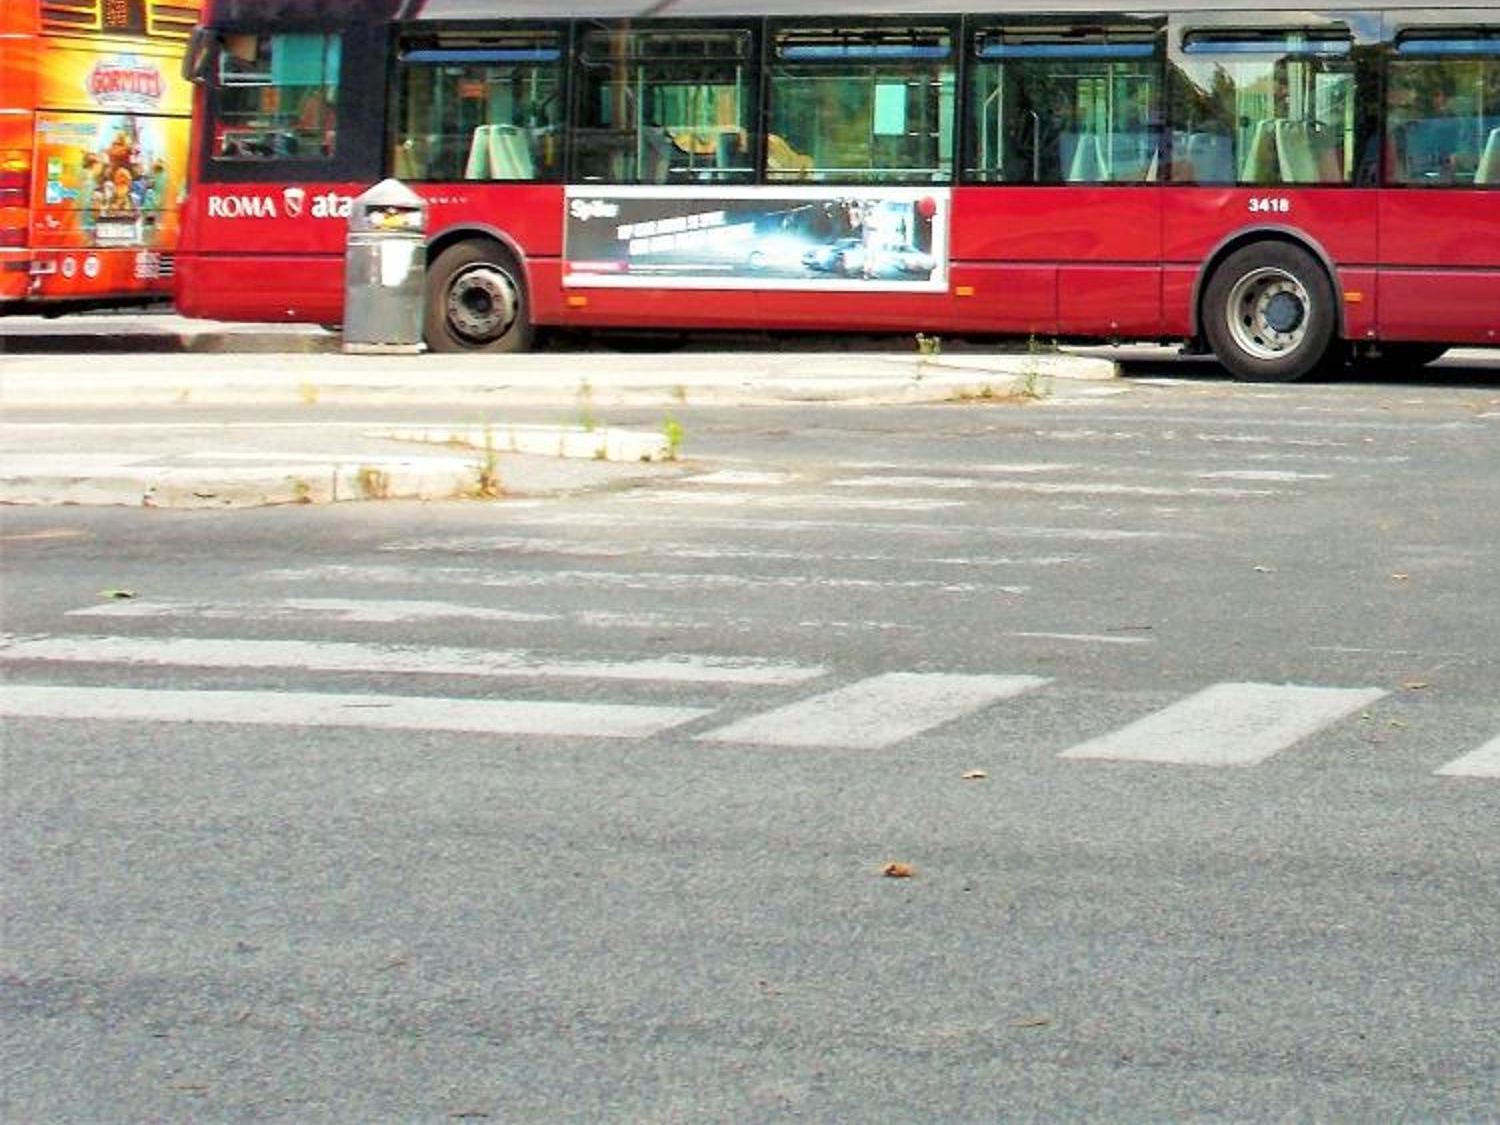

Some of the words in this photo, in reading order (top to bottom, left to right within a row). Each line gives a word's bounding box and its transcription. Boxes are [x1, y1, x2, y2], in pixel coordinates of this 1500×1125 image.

[208, 196, 277, 217] ROMA
[311, 195, 352, 217] ata
[1248, 198, 1290, 212] 3418
